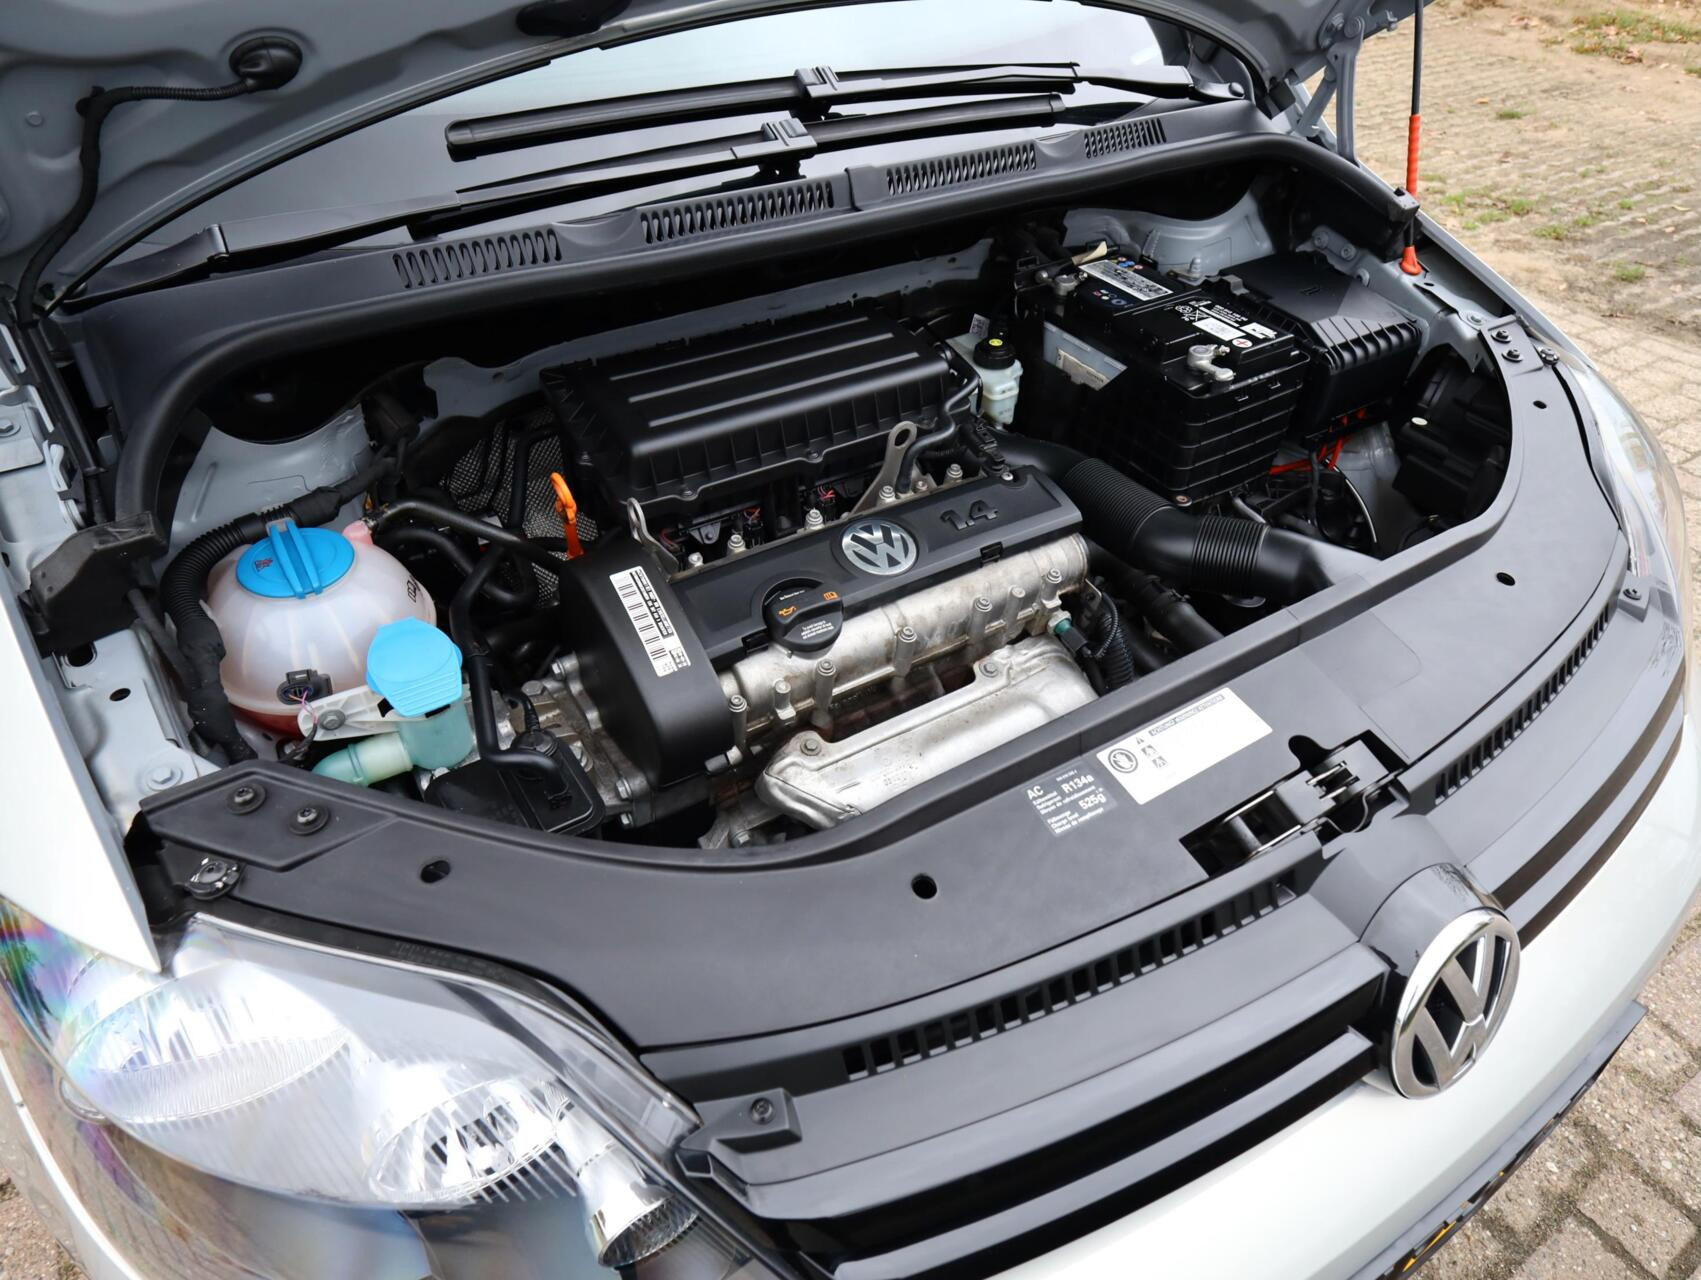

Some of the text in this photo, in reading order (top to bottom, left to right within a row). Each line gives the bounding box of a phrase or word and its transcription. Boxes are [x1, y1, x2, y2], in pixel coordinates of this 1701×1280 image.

[941, 500, 1000, 530] 1.4
[846, 519, 915, 575] VW
[1026, 785, 1044, 800] AC
[1060, 774, 1095, 794] R134a
[1078, 793, 1107, 810] 525g
